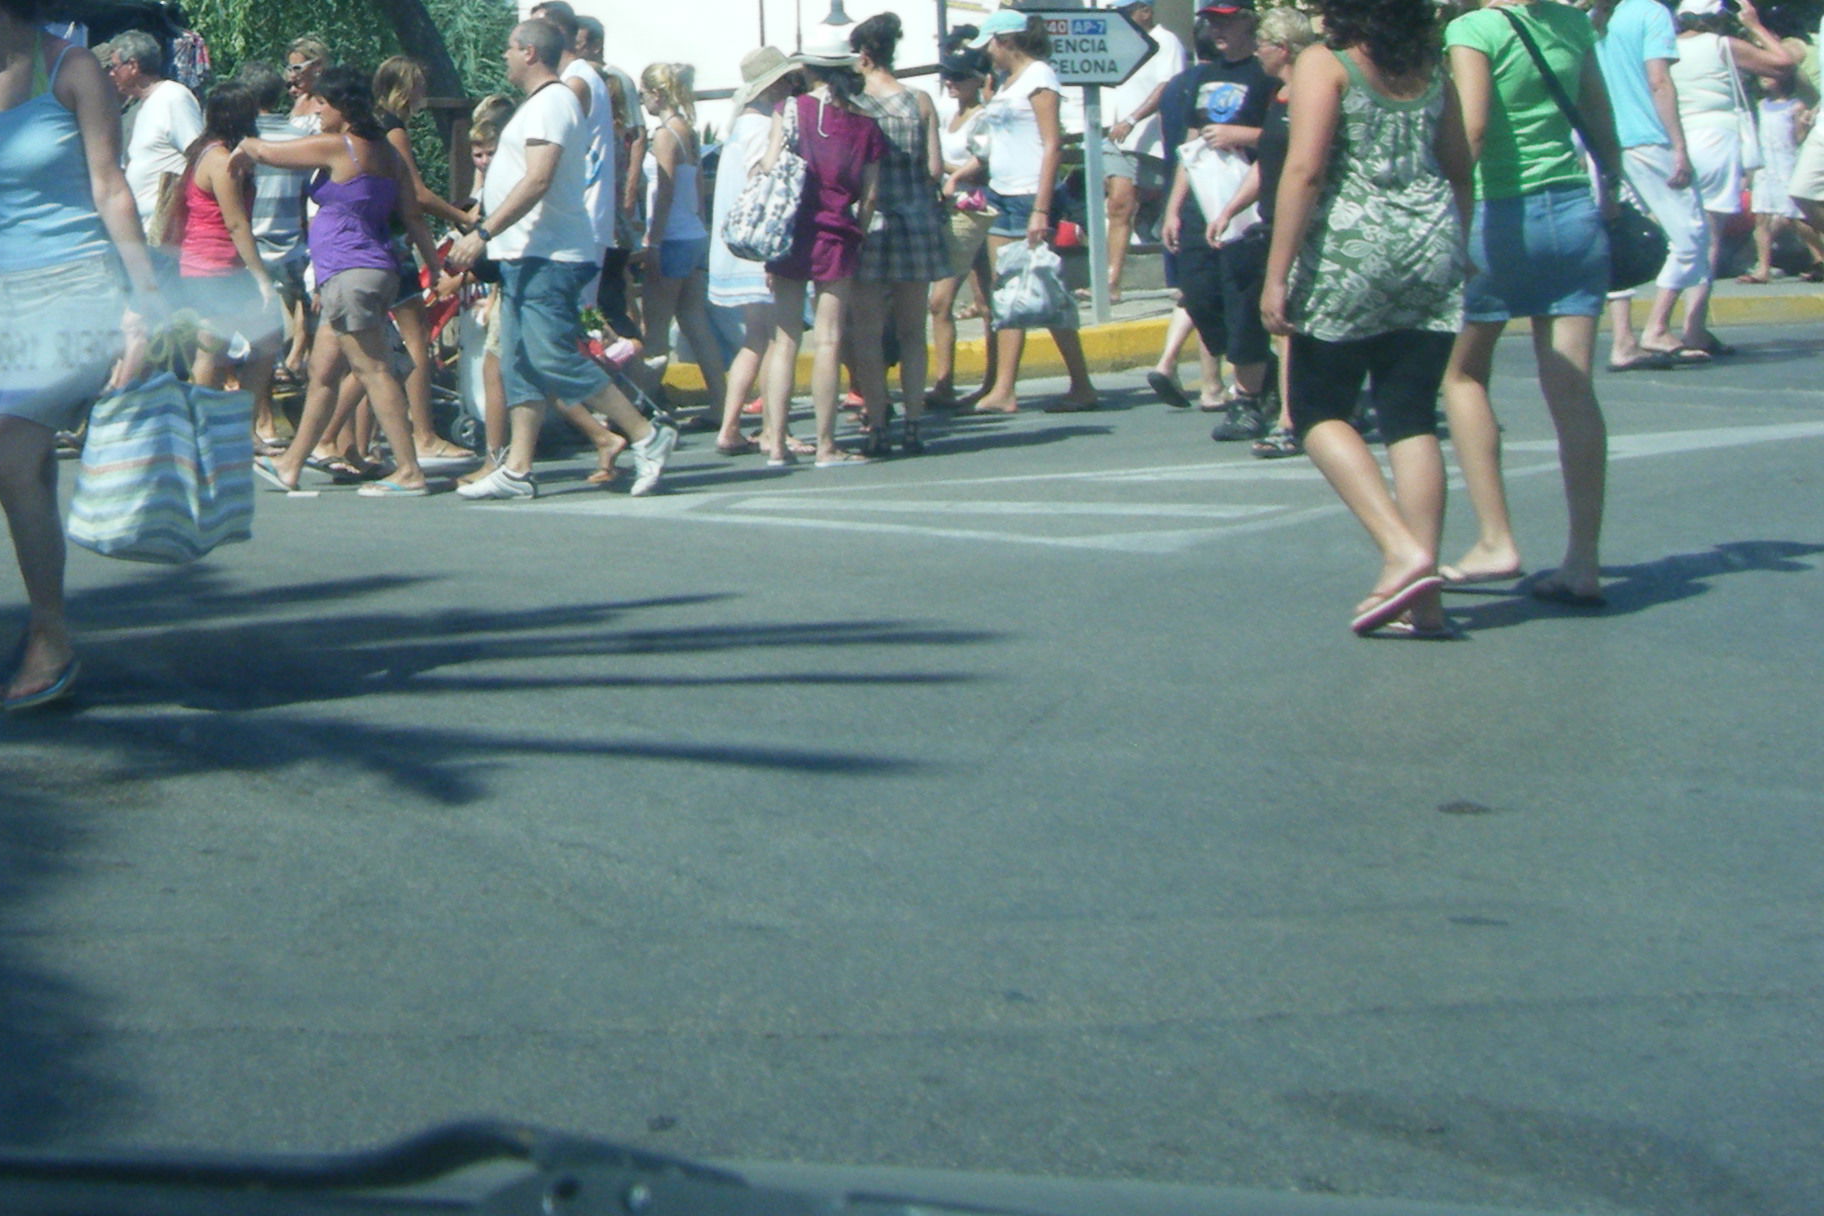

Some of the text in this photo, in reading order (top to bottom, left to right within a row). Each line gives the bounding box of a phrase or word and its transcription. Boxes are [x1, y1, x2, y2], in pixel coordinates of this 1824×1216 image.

[1073, 19, 1106, 34] AP-7
[1054, 38, 1108, 54] ENCIA
[1049, 58, 1118, 74] CELONA
